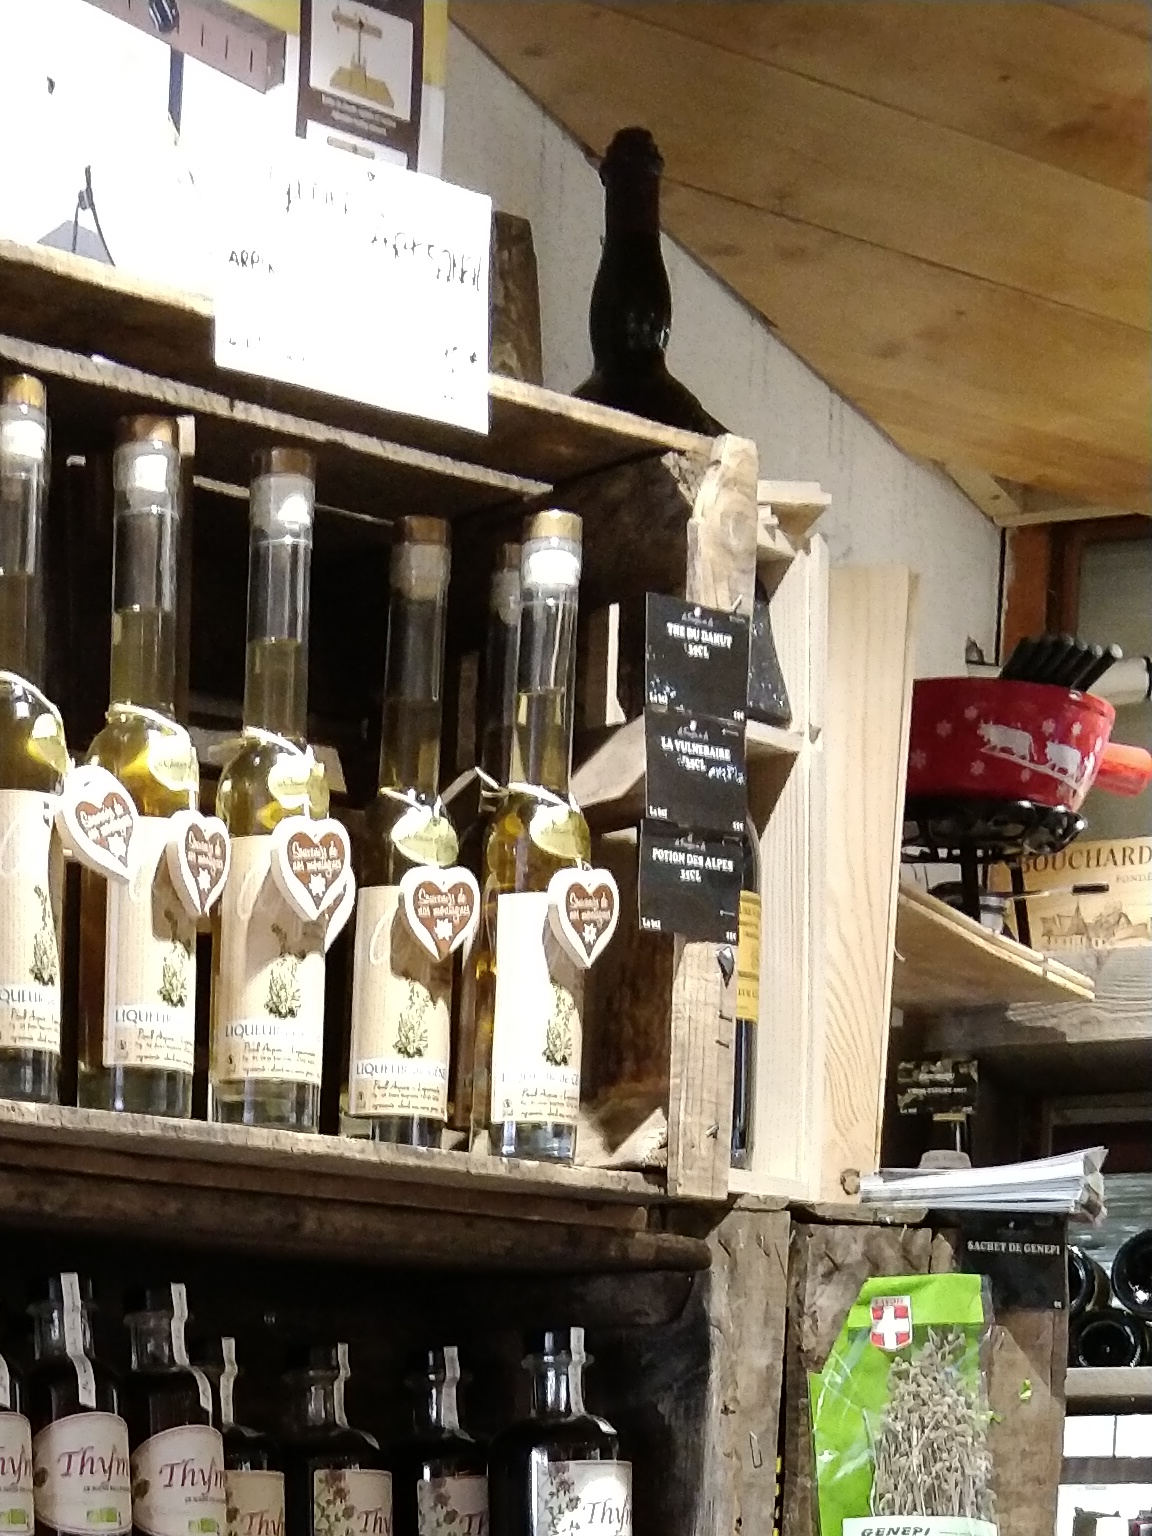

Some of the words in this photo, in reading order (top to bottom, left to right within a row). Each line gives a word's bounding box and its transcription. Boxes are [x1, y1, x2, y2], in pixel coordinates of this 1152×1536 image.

[652, 846, 686, 866] POTION
[686, 853, 704, 869] DES
[705, 856, 734, 873] ALPES
[967, 1241, 1007, 1252] SACHET
[1008, 1242, 1022, 1253] DE
[1023, 1243, 1061, 1255] GENEPI
[860, 1527, 931, 1536] GENEPI
